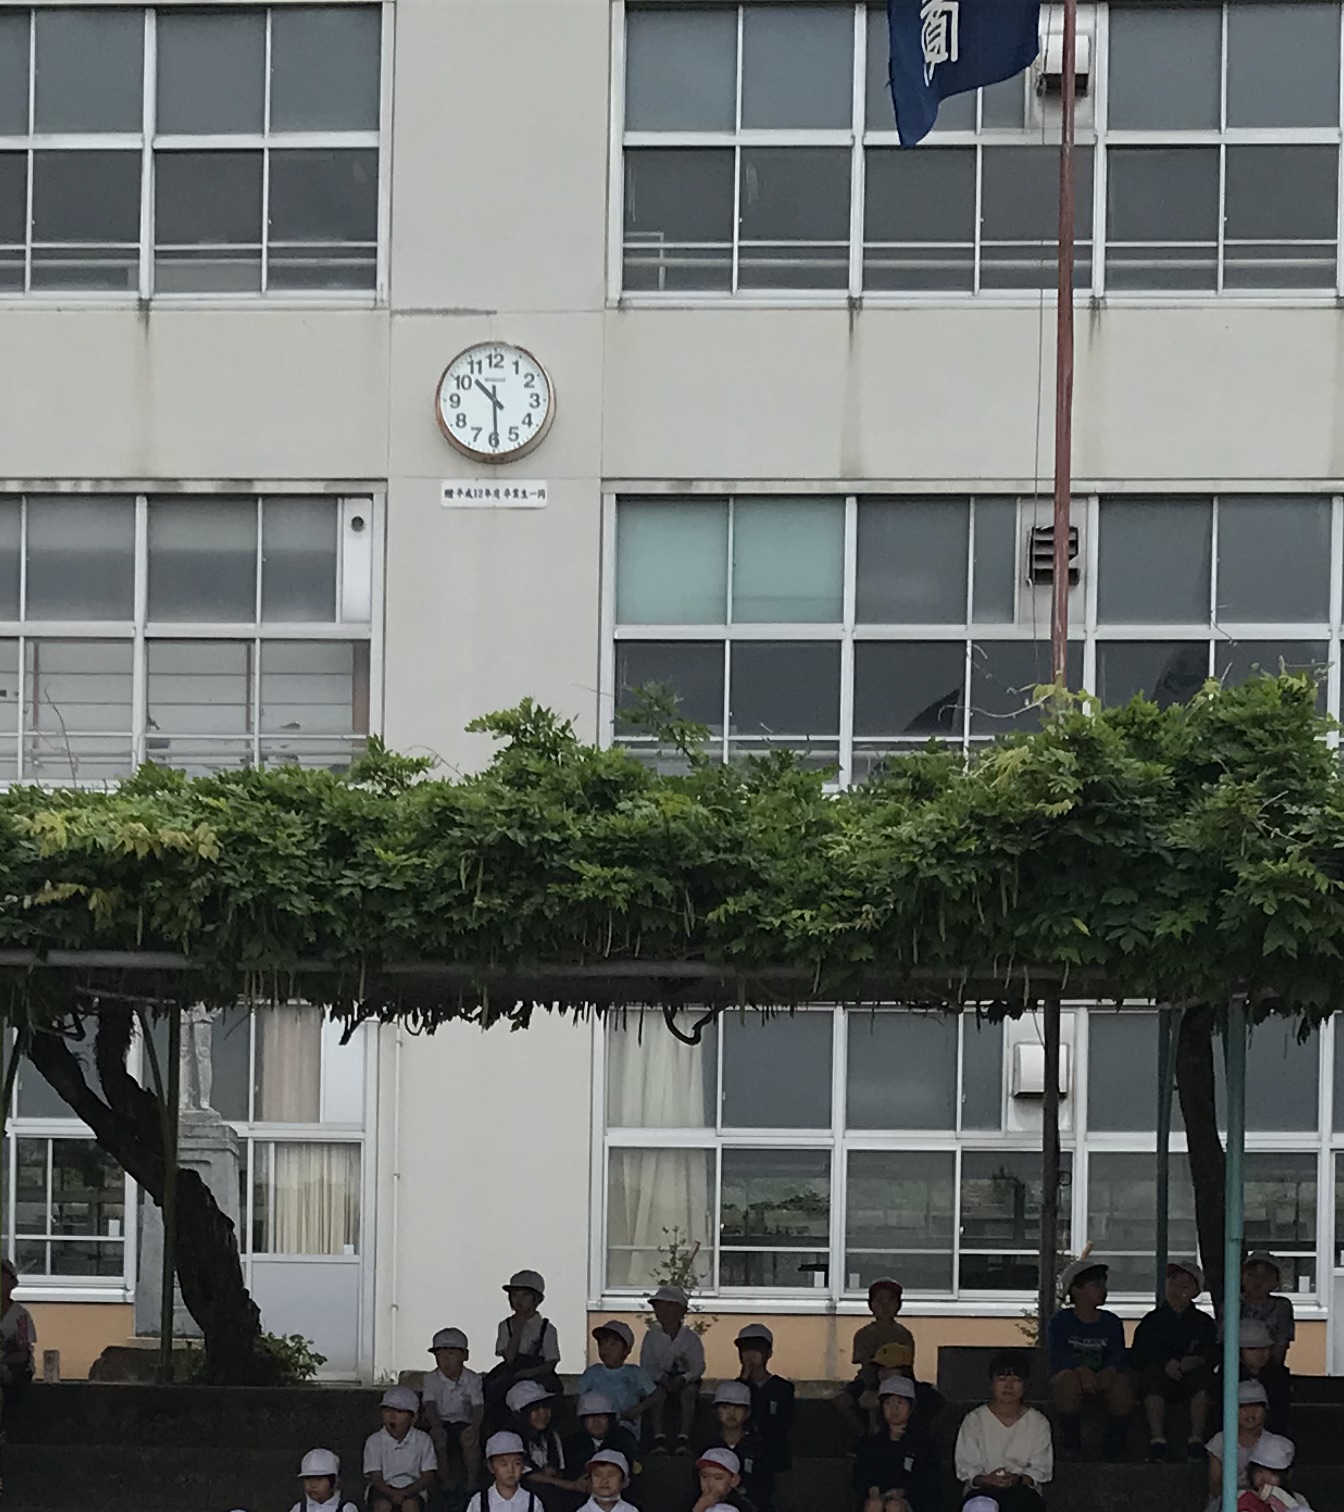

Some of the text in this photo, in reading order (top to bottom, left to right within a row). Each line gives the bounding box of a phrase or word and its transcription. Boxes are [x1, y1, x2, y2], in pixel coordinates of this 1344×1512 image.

[468, 360, 483, 375] 11
[486, 353, 505, 369] 12
[512, 360, 520, 375] 1
[456, 375, 472, 390] 10
[524, 373, 535, 388] 2
[449, 393, 461, 409] 9
[529, 393, 541, 409] 3
[456, 413, 467, 428] 8
[521, 413, 533, 428] 4
[471, 427, 483, 442] 7
[488, 432, 500, 448] 6
[508, 426, 519, 442] 5
